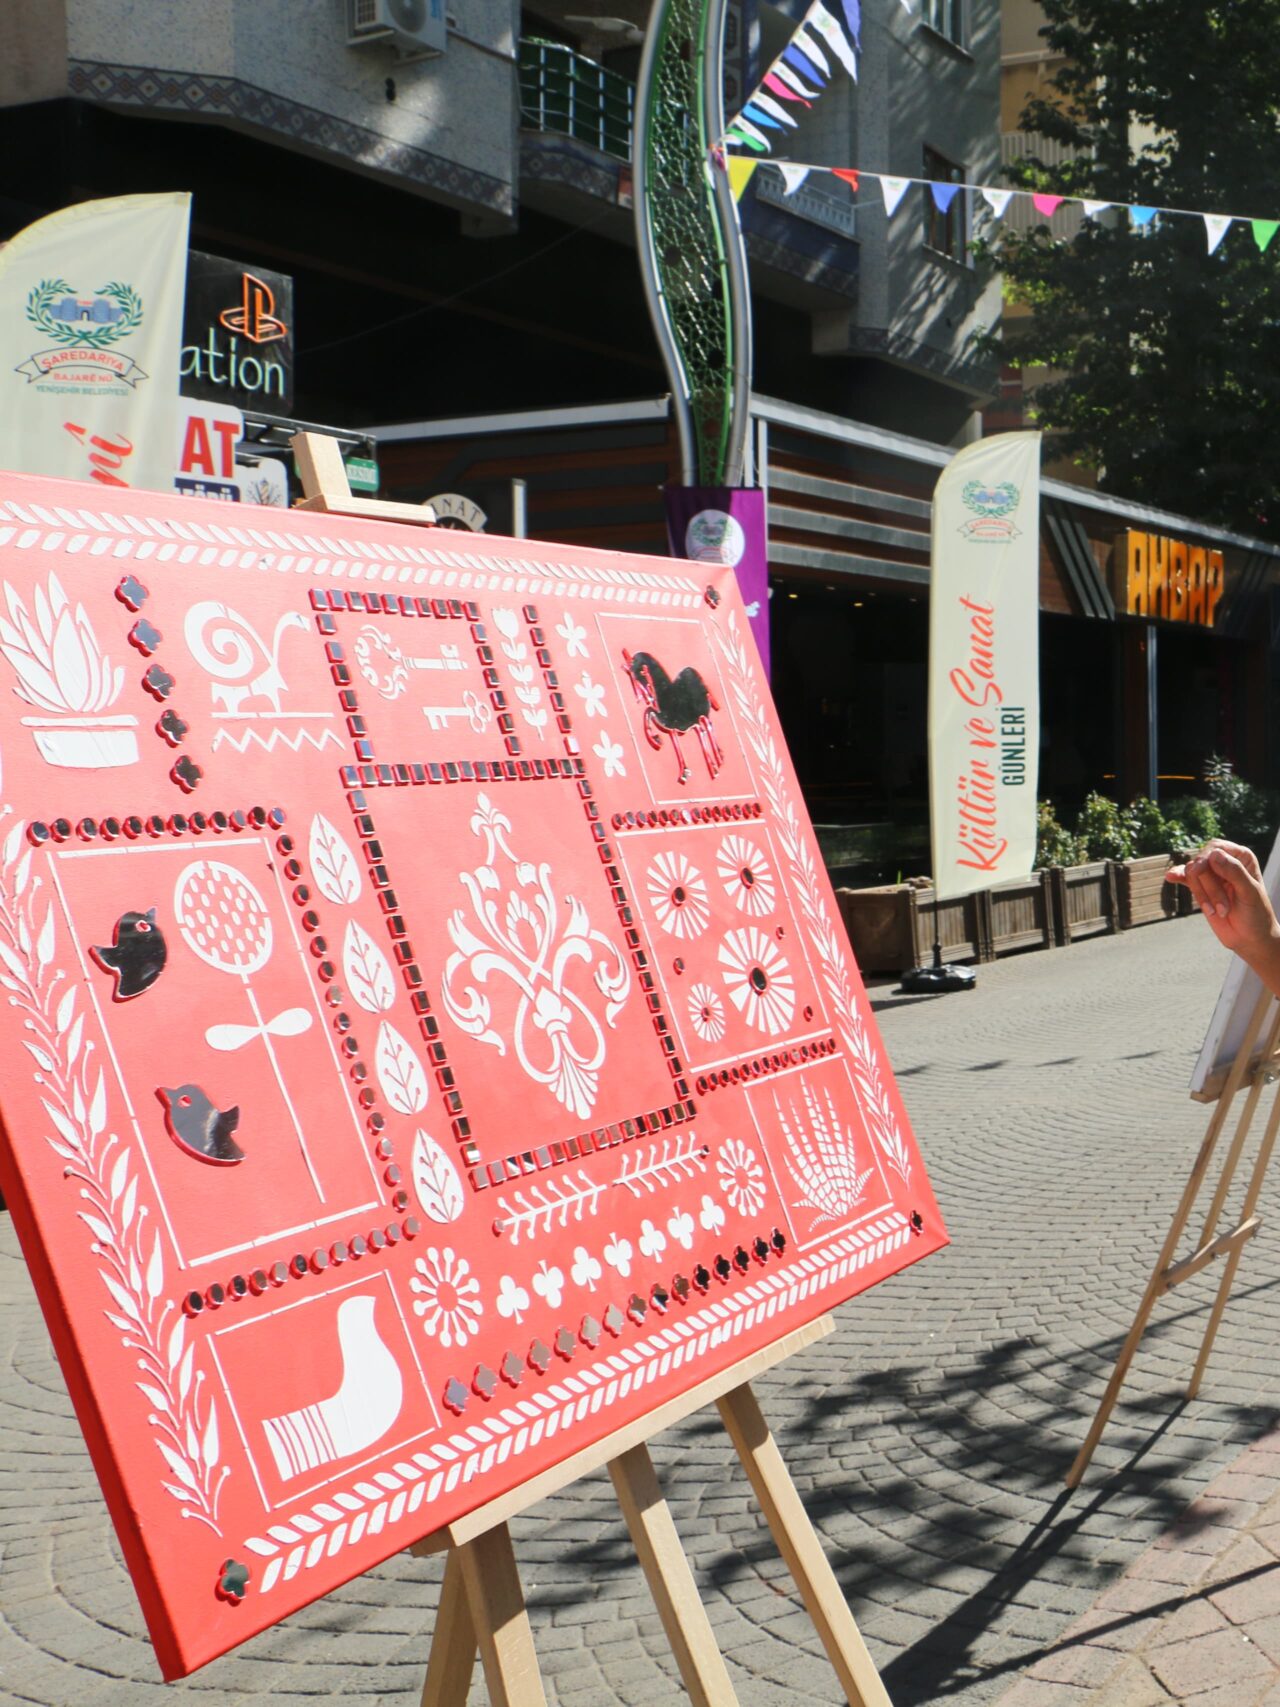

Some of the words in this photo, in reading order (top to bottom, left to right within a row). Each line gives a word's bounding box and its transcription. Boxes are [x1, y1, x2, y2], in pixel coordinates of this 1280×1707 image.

[180, 415, 240, 479] AT
[1126, 526, 1225, 629] AHBAP
[949, 593, 1003, 707] Sanat
[963, 717, 998, 749] ve
[995, 706, 1026, 787] GÜNLERİ
[956, 758, 1008, 872] Kültür
